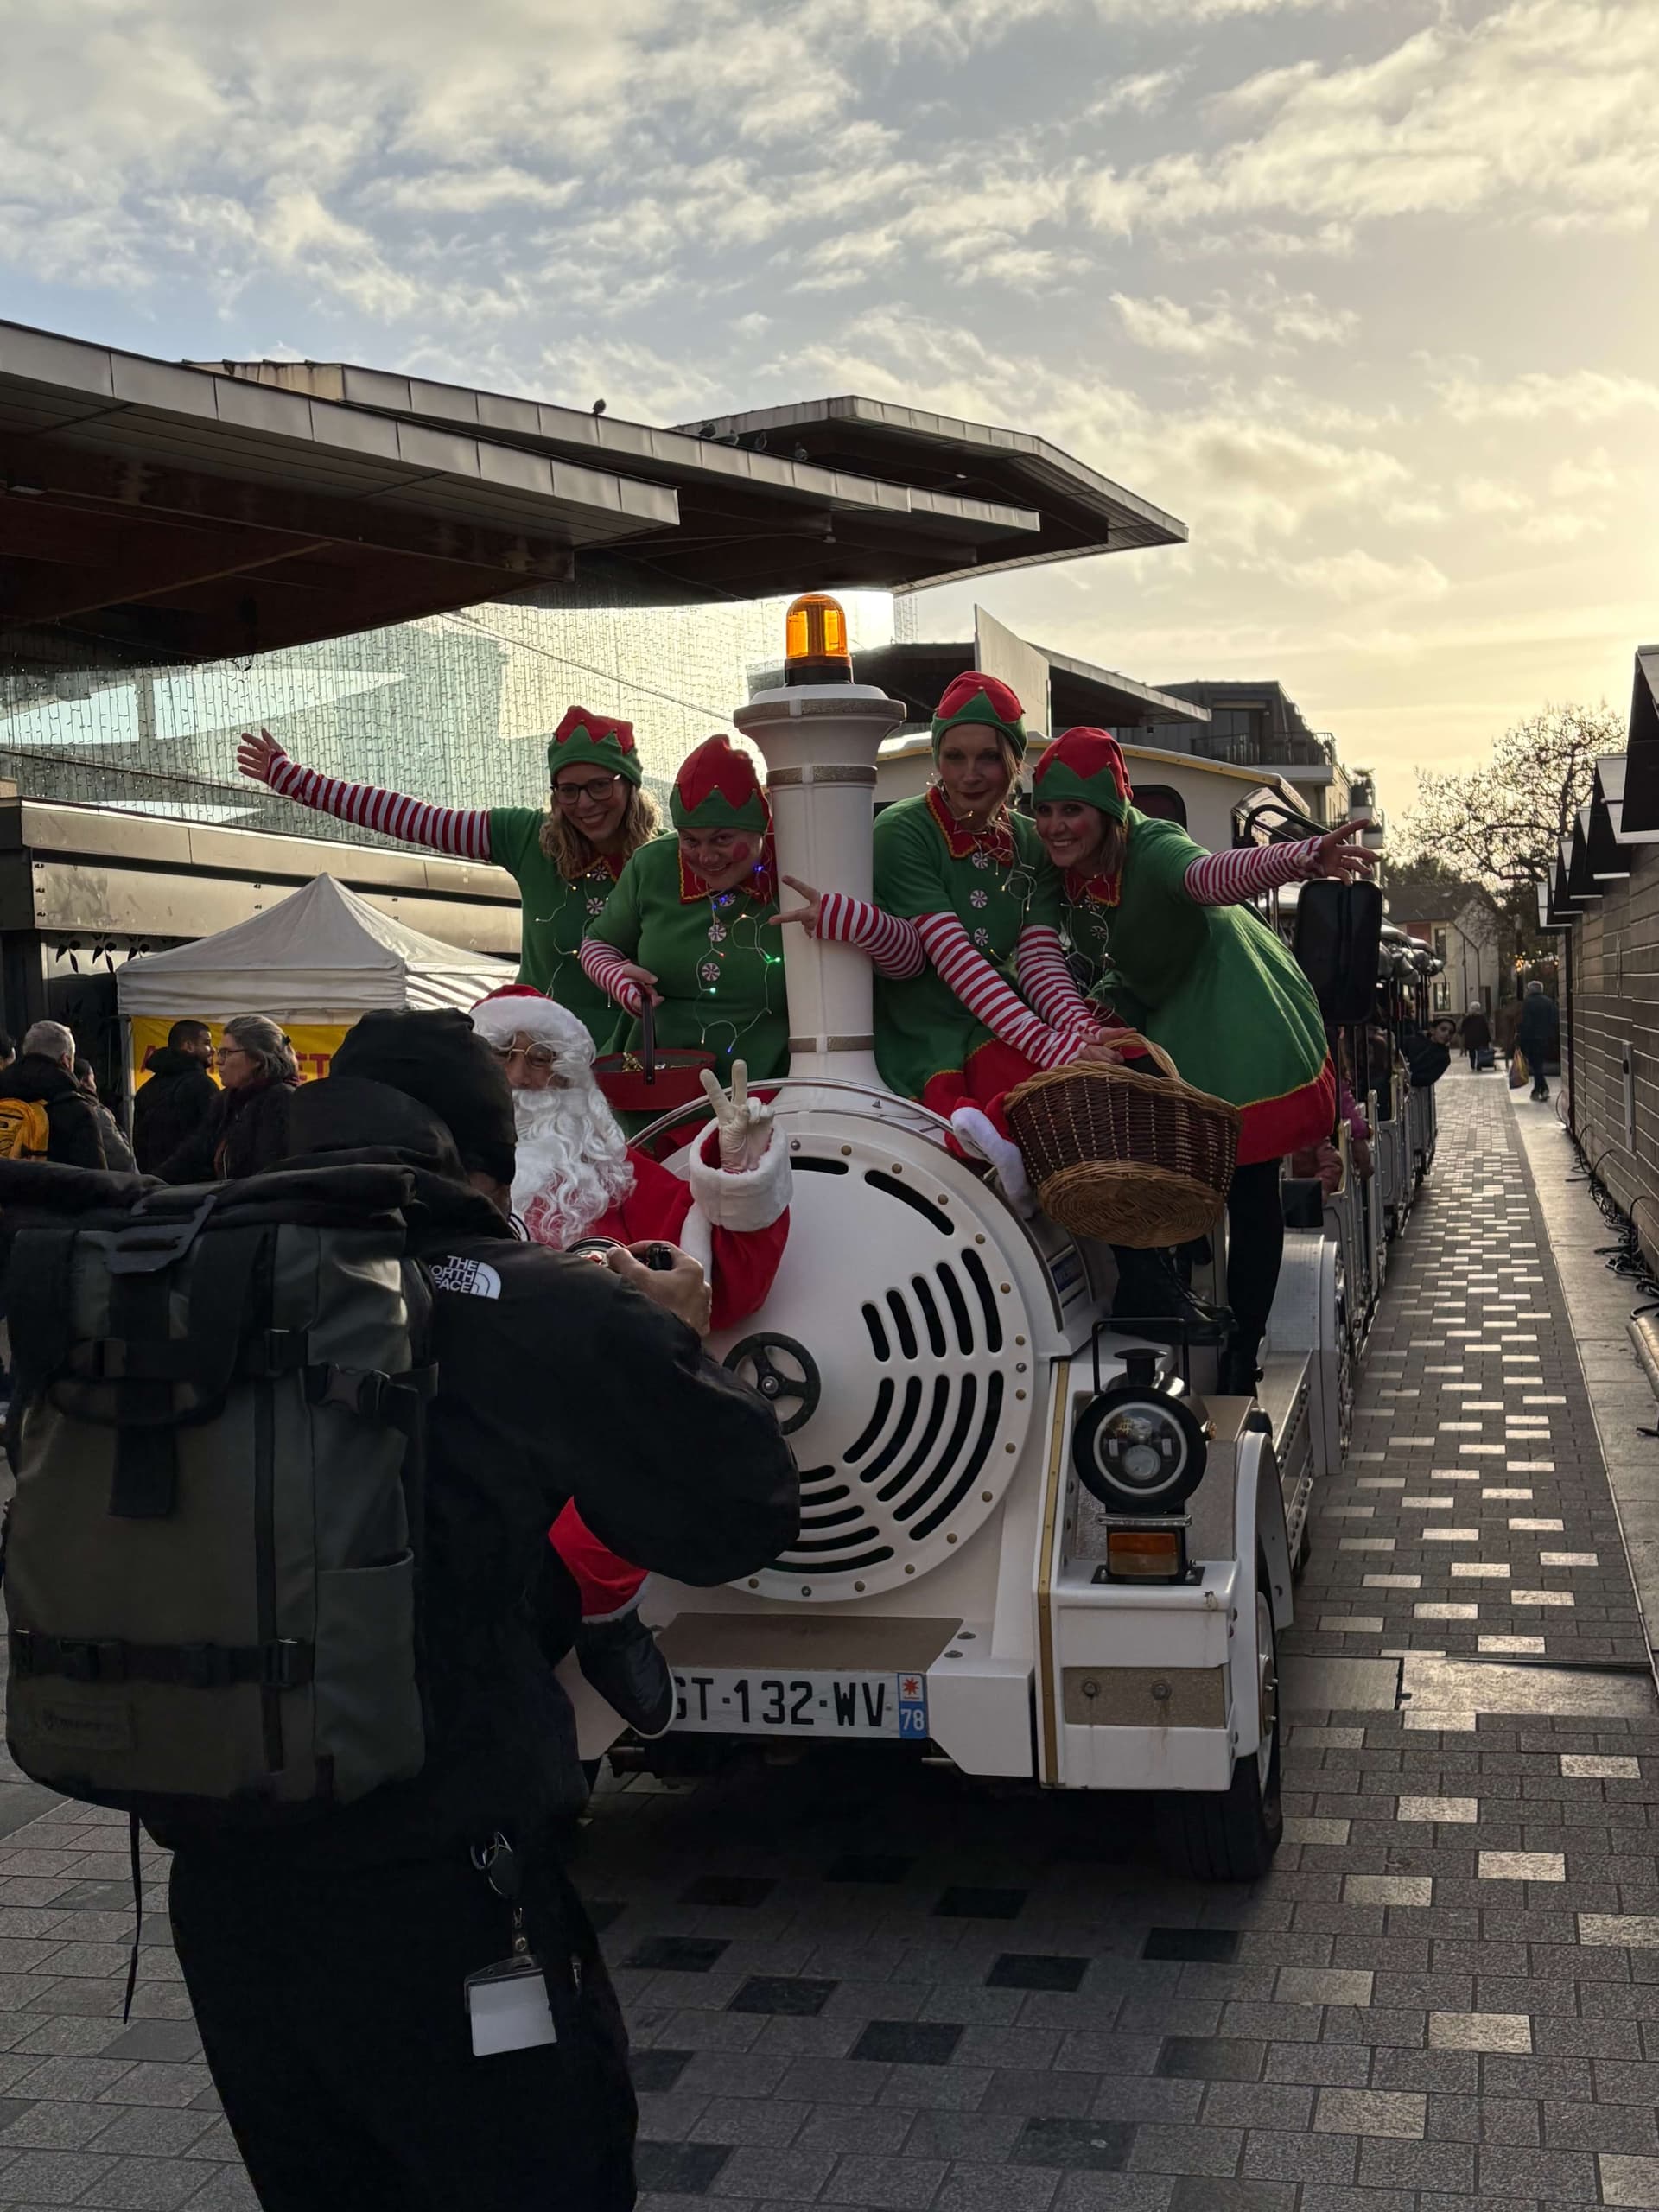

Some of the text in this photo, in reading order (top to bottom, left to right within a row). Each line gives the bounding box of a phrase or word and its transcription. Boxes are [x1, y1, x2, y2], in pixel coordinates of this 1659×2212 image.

[447, 1255, 480, 1271] THE
[429, 1265, 475, 1282] ORTH
[435, 1277, 472, 1294] FACE
[900, 1708, 925, 1731] 78
